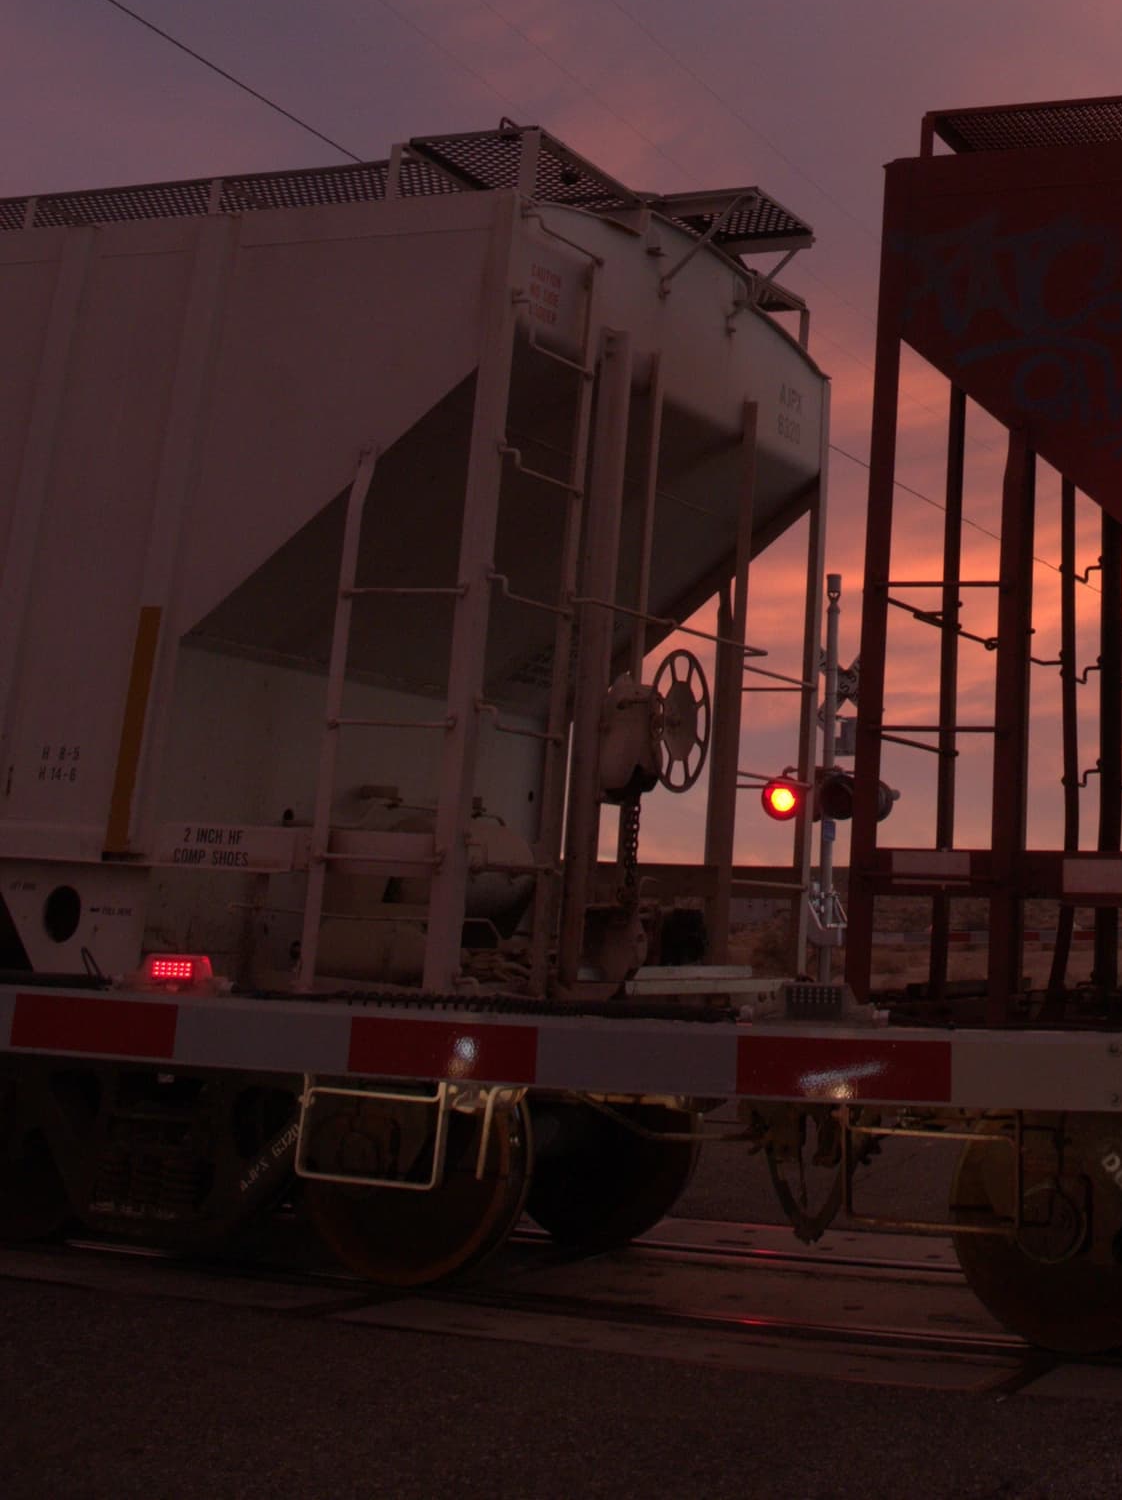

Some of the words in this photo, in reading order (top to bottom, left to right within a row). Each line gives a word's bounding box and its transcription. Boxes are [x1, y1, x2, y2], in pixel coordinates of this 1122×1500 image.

[184, 827, 192, 843] 2
[197, 827, 223, 845] INCH
[228, 829, 244, 845] HF
[174, 847, 206, 864] COMP
[211, 851, 249, 867] SHOES
